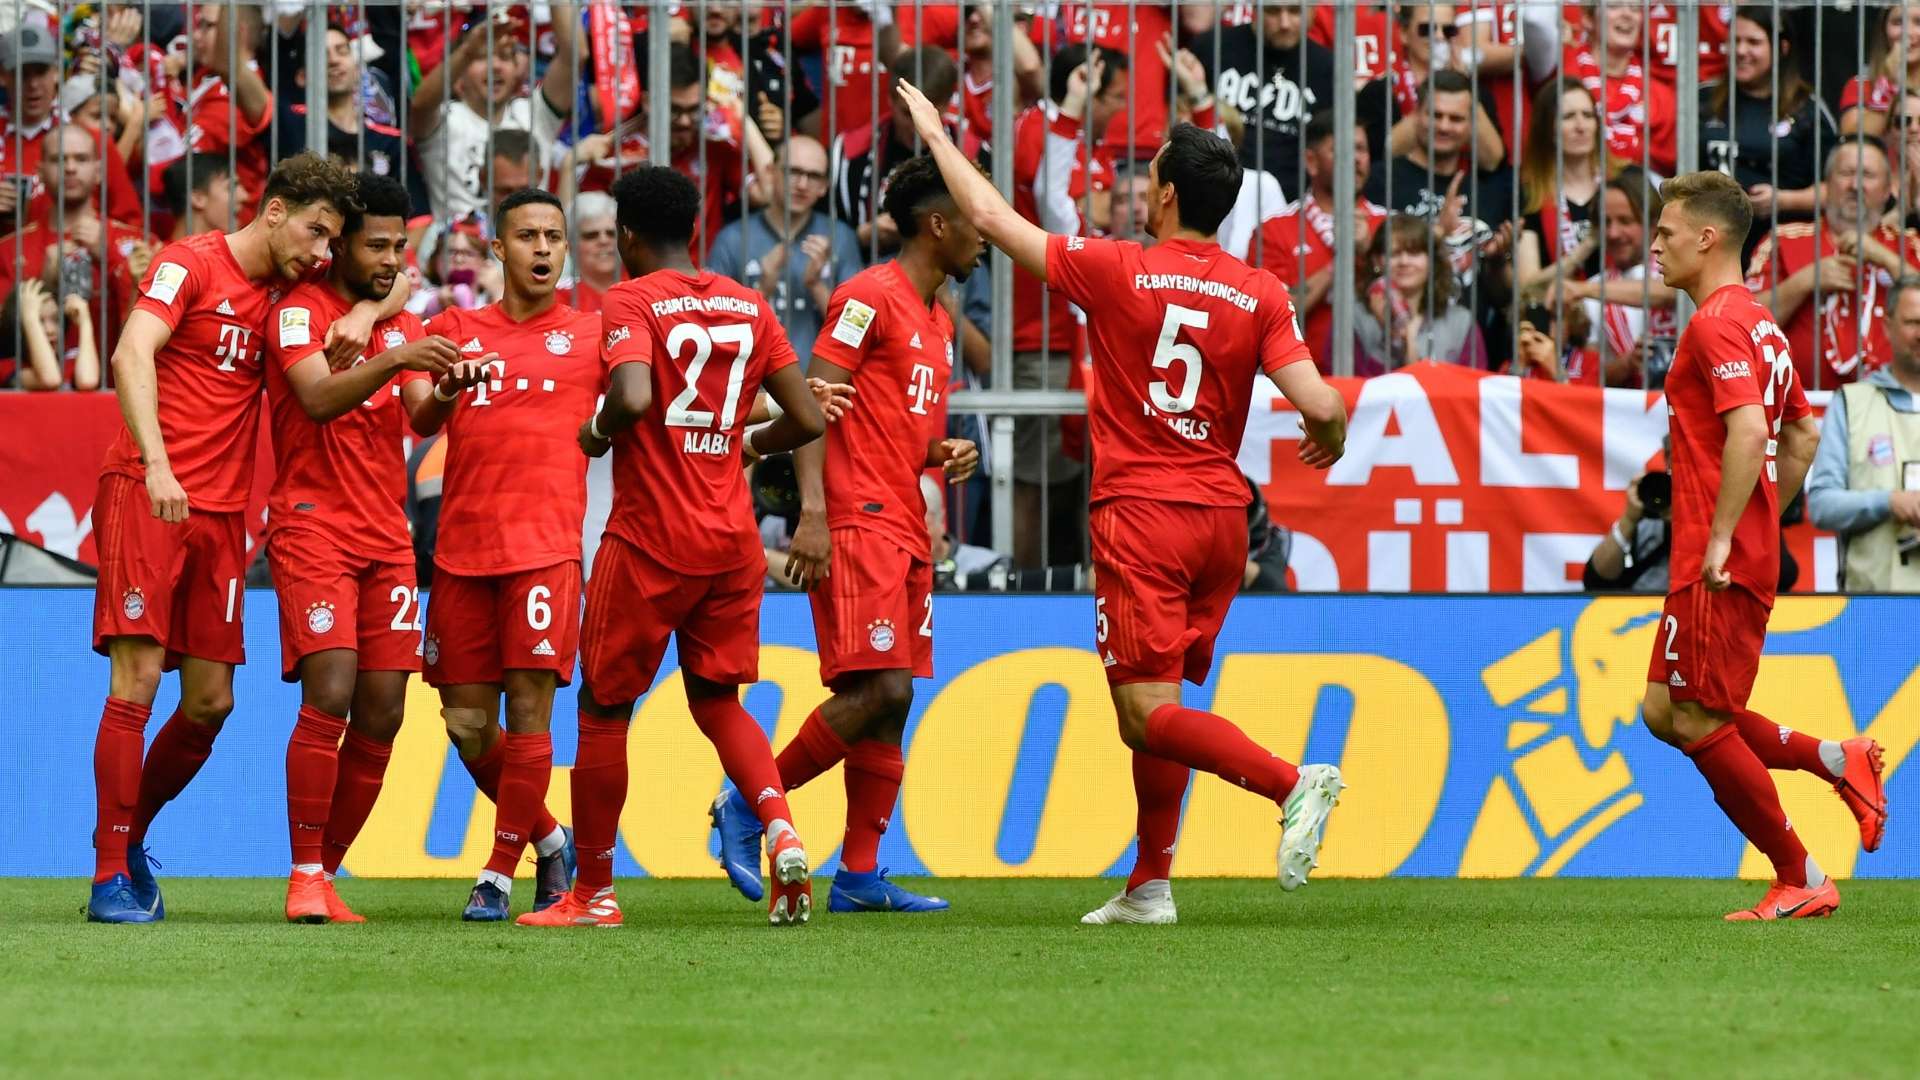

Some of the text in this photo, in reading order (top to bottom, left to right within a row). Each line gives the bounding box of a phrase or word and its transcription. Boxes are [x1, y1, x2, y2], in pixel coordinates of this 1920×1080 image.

[667, 296, 705, 315] BAYEN
[1148, 303, 1209, 414] 5
[1712, 360, 1751, 378] QATAR
[665, 322, 755, 431] 27
[1143, 401, 1210, 441] MELS
[683, 431, 730, 456] ALABA
[526, 585, 553, 631] 6
[1664, 614, 1680, 661] 2
[113, 825, 130, 833] FC
[496, 831, 519, 842] FCB
